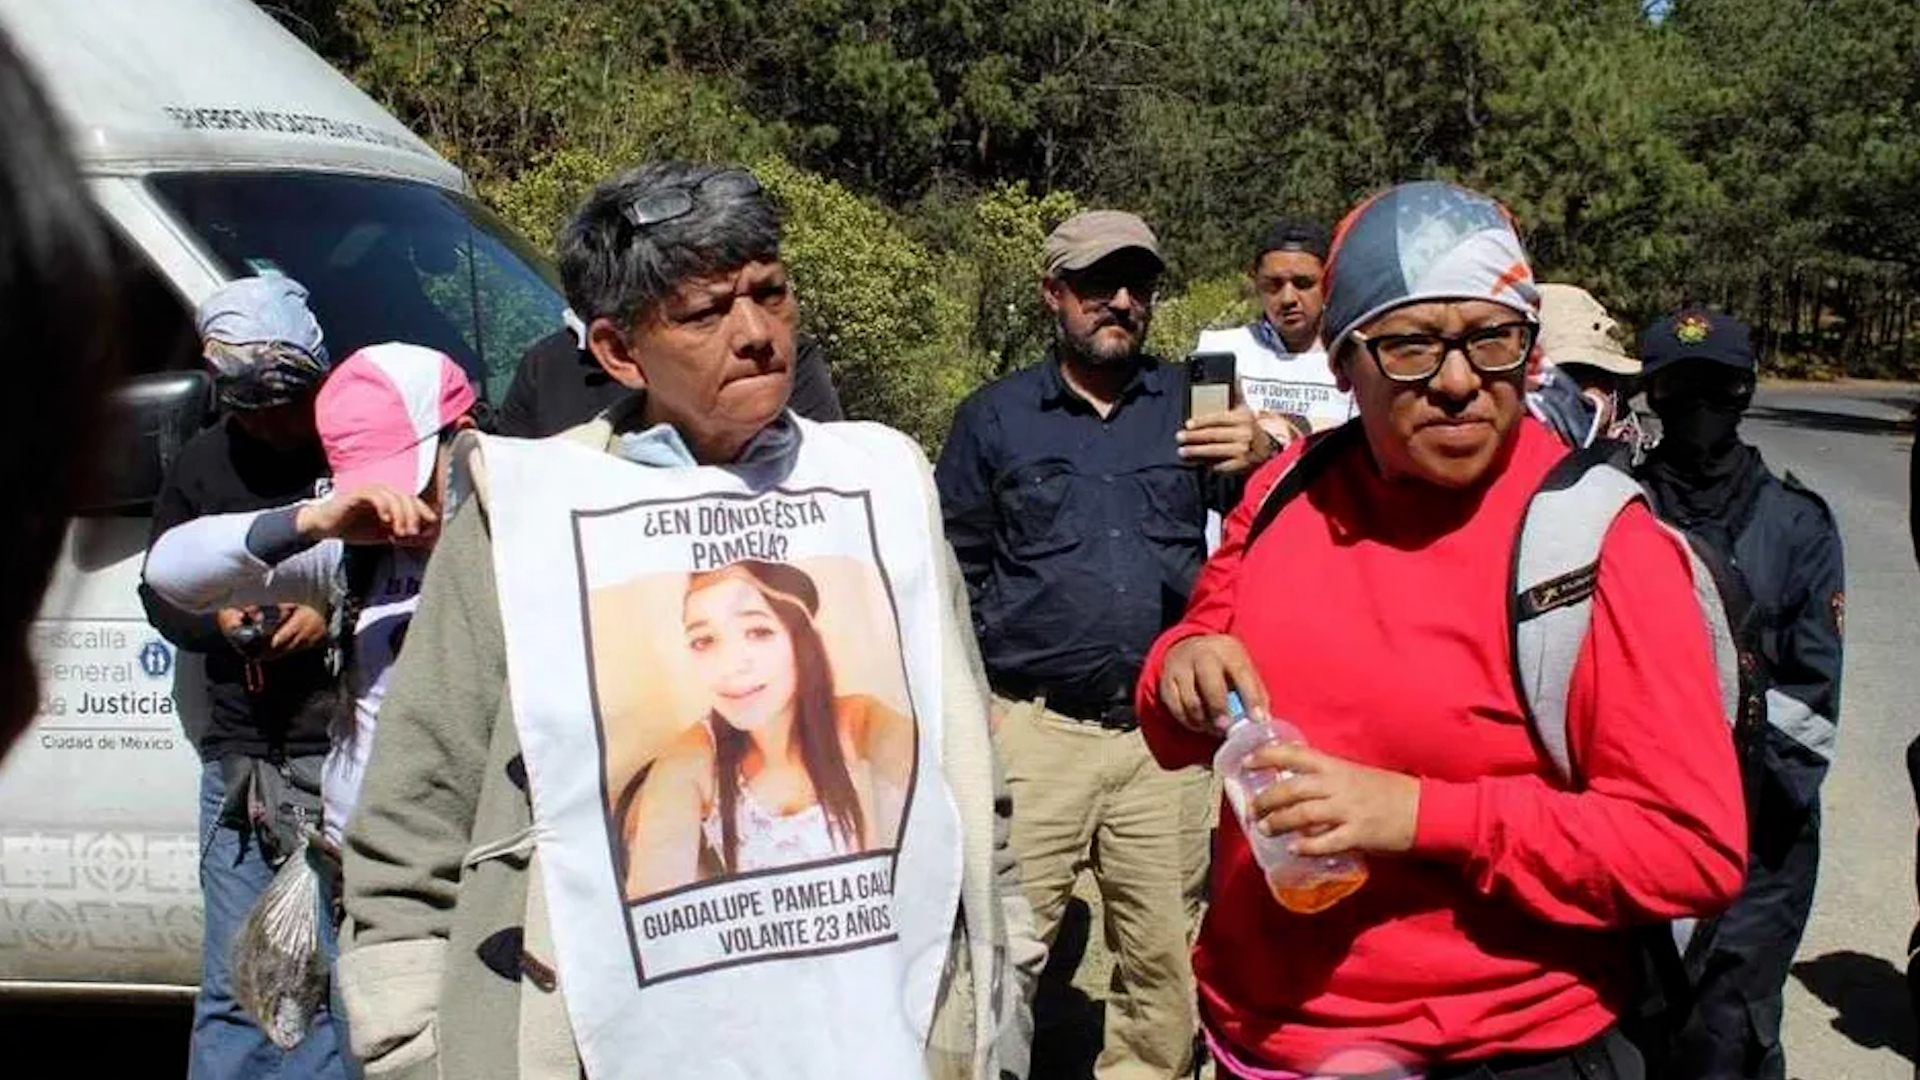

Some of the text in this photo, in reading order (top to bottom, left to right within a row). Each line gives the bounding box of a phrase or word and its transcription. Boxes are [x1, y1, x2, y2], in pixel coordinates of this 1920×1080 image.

[643, 507, 691, 537] ¿EN
[699, 499, 772, 536] DÓNDE
[692, 530, 788, 569] PAMELA?
[36, 627, 126, 649] iscalía
[76, 692, 172, 714] Justicia
[41, 734, 174, 750] Ciudad de México
[643, 891, 764, 940] GUADALUPE
[772, 875, 854, 913] PAMELA
[719, 903, 892, 954] VOLANTE 23 AÑOS
